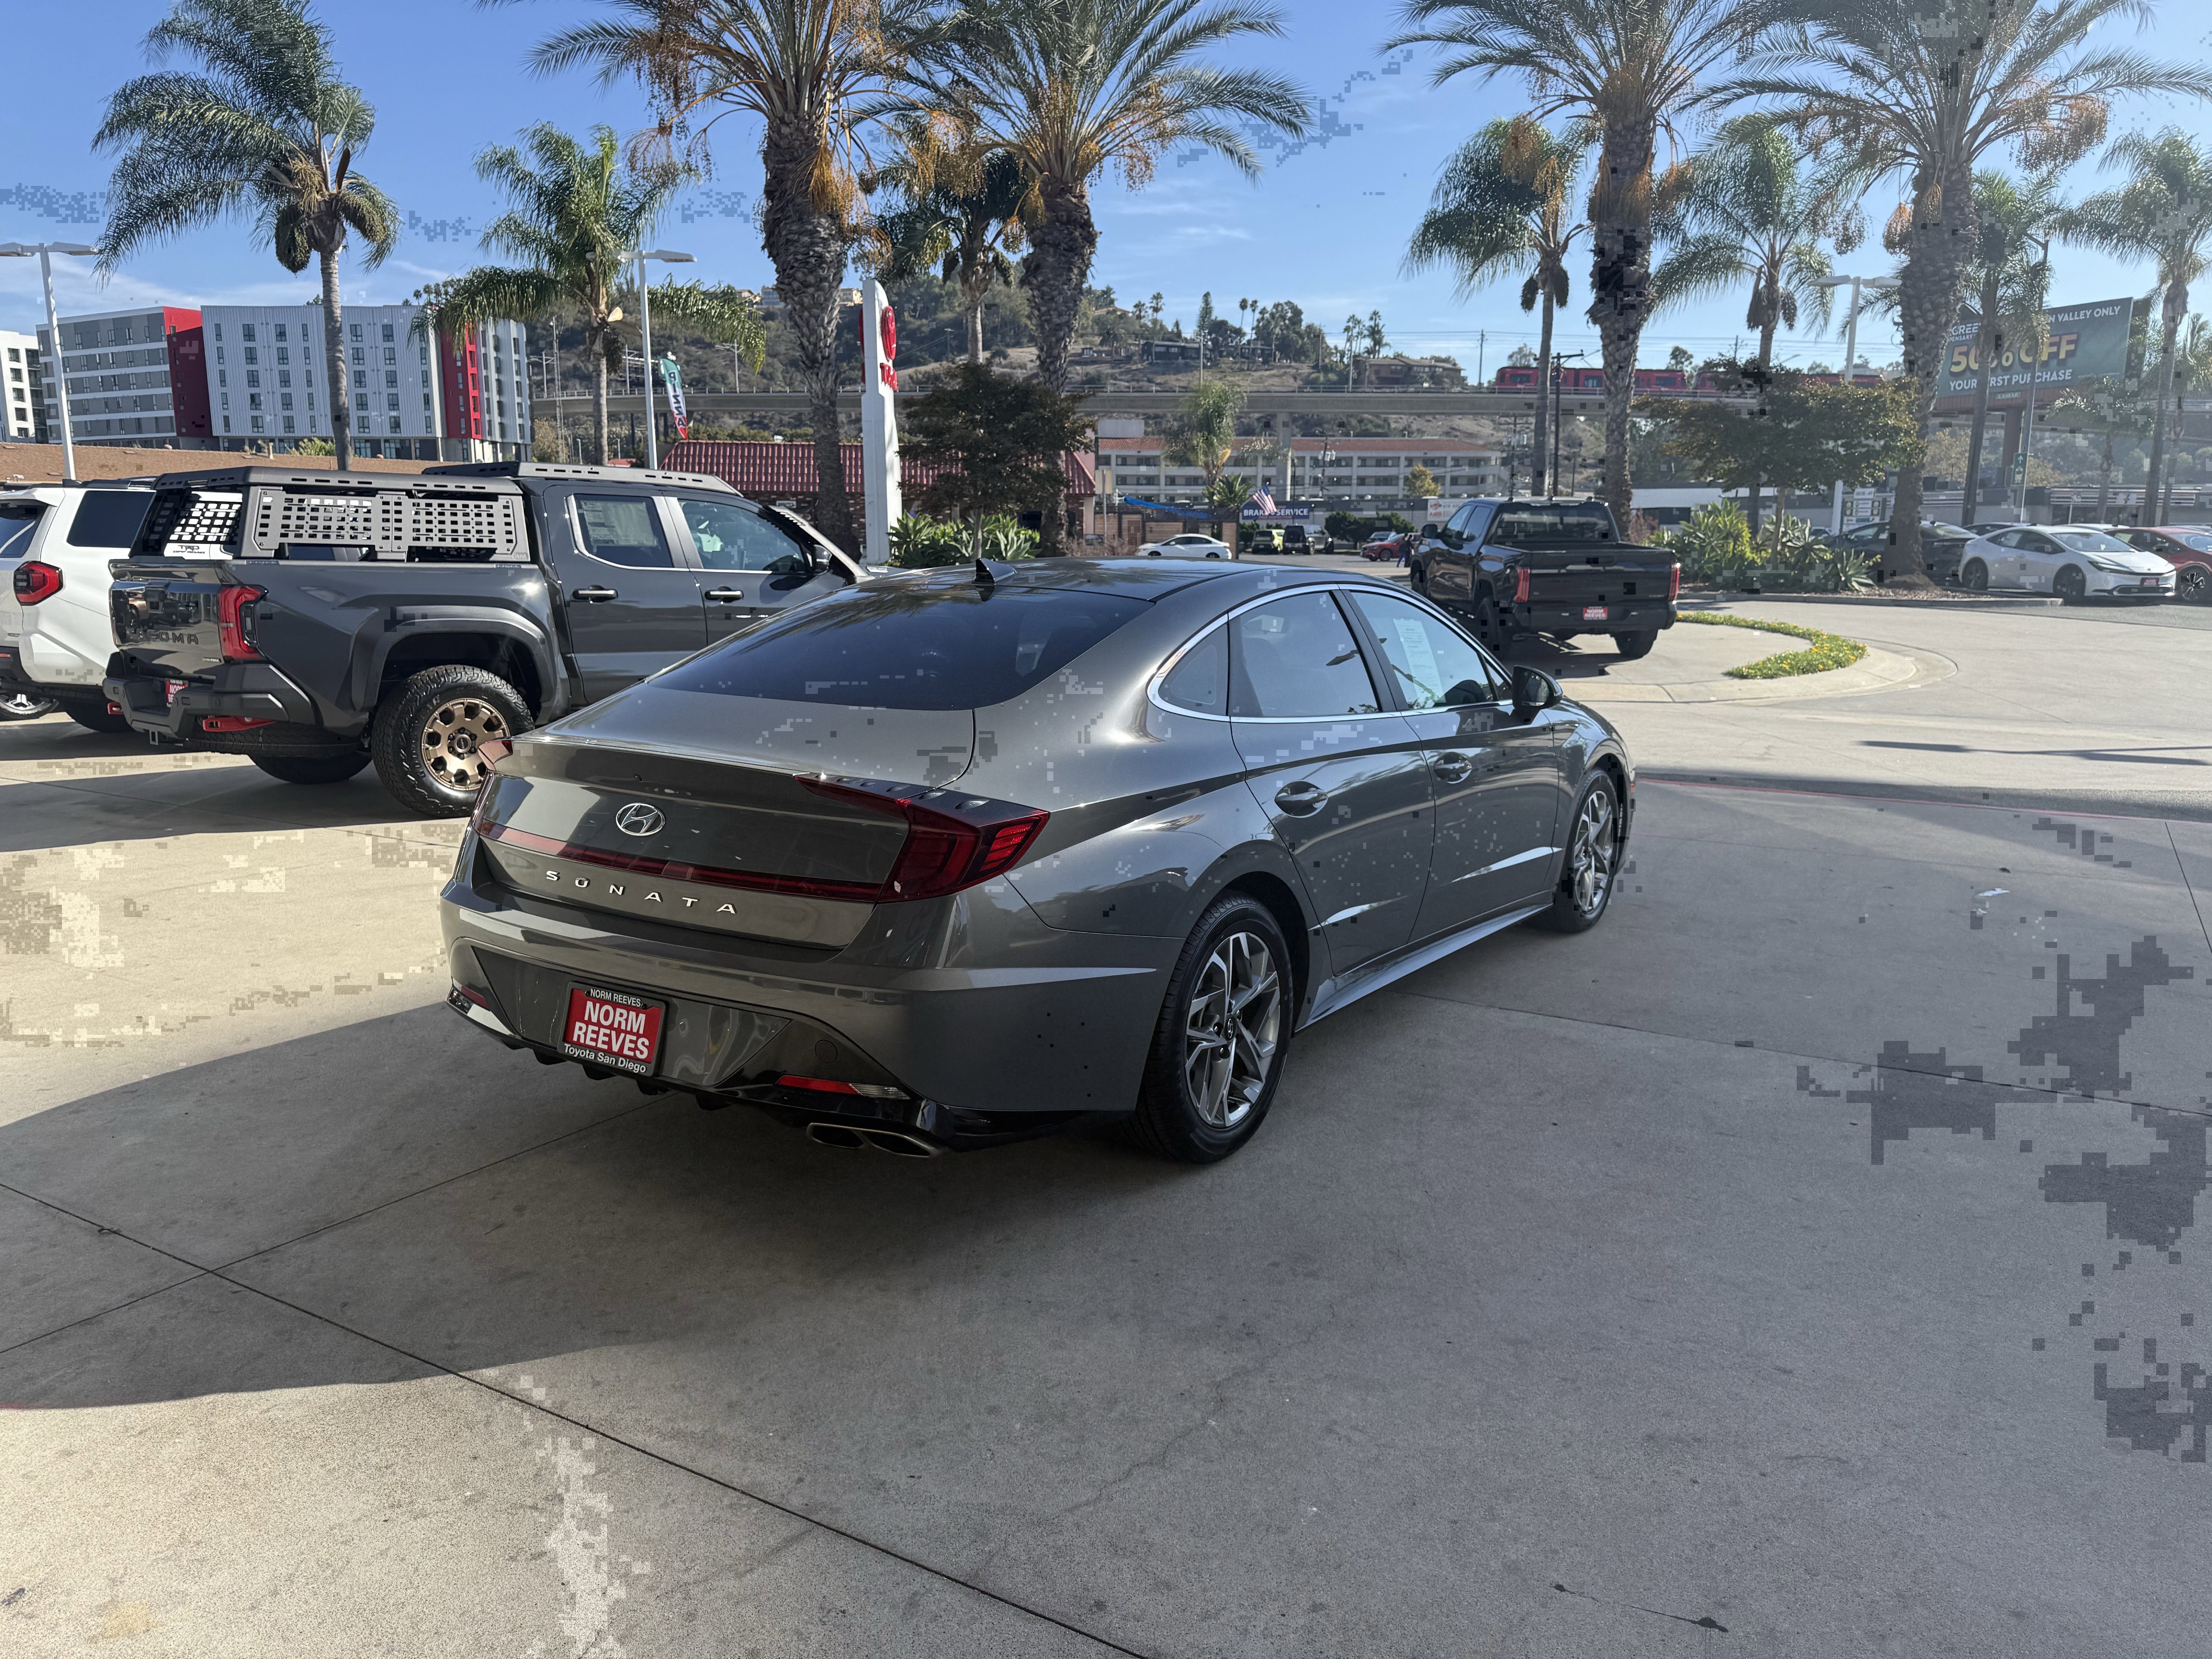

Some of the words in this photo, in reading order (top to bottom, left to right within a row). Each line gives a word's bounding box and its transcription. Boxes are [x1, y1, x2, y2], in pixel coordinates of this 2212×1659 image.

[2058, 310, 2092, 322] VALLEY
[2094, 306, 2120, 317] ONLY
[1951, 323, 1980, 335] GREE
[1950, 379, 1977, 390] YOUR
[1990, 374, 2010, 386] RST
[546, 870, 736, 914] SONATA
[591, 988, 612, 1001] NORM
[613, 993, 642, 1007] REEVES
[584, 1001, 646, 1034] NORM
[573, 1022, 649, 1059] REEVES
[564, 1044, 595, 1060] Toyota
[597, 1052, 616, 1065] San
[618, 1058, 646, 1073] Diego
